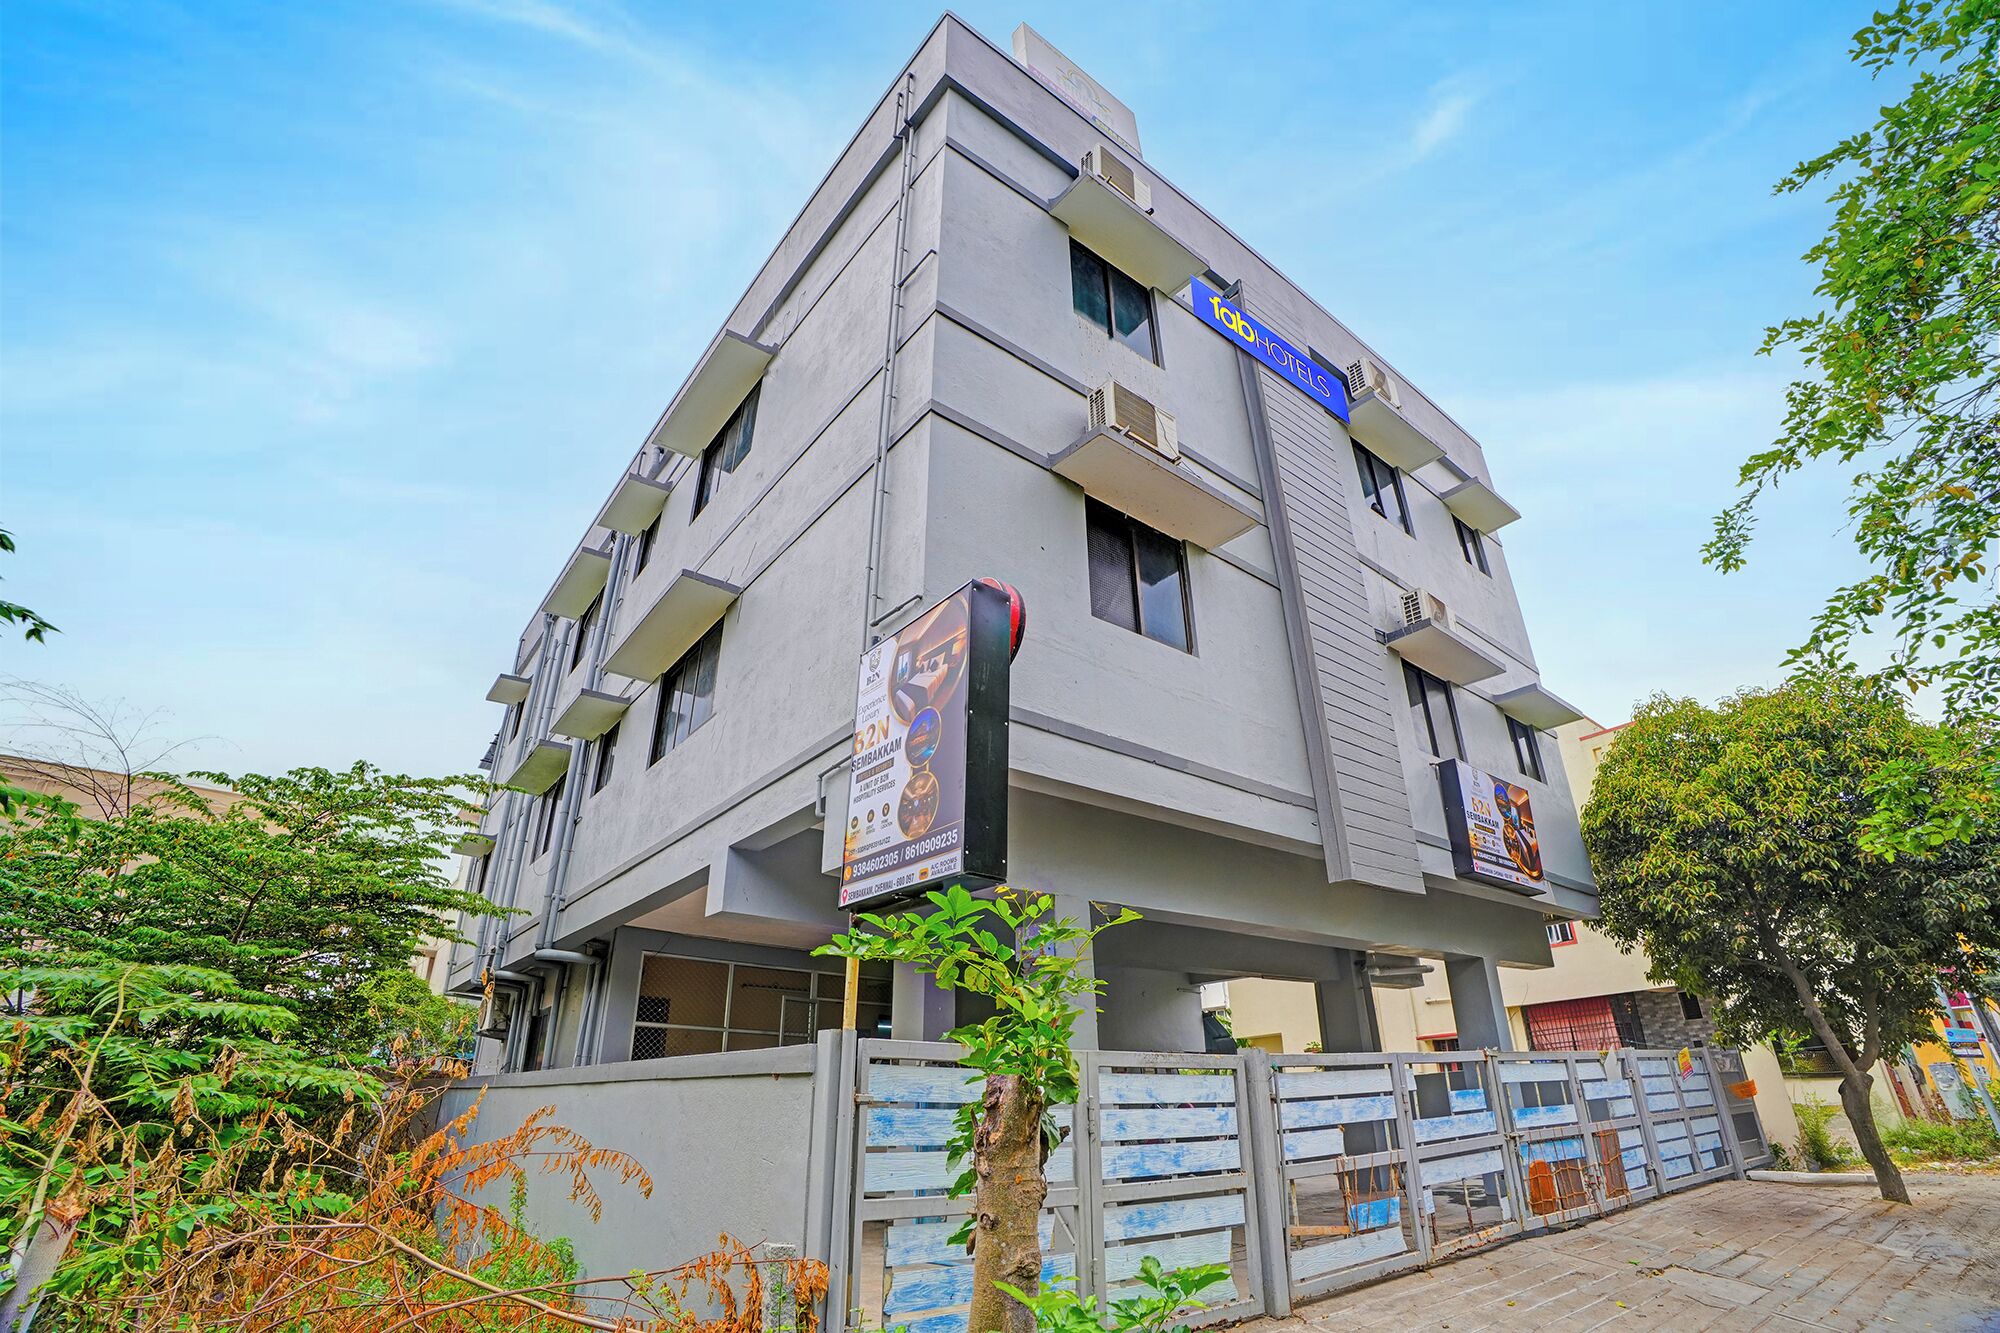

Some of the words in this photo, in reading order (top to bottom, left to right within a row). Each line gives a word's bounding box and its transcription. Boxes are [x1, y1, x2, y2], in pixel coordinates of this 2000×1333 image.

[853, 715, 890, 756] B2N
[851, 737, 902, 772] SEMBAKKAM
[852, 851, 899, 877] 9384602305
[905, 829, 958, 860] 8610909235
[931, 864, 957, 877] AVAILABLE
[940, 856, 958, 867] ROOMS
